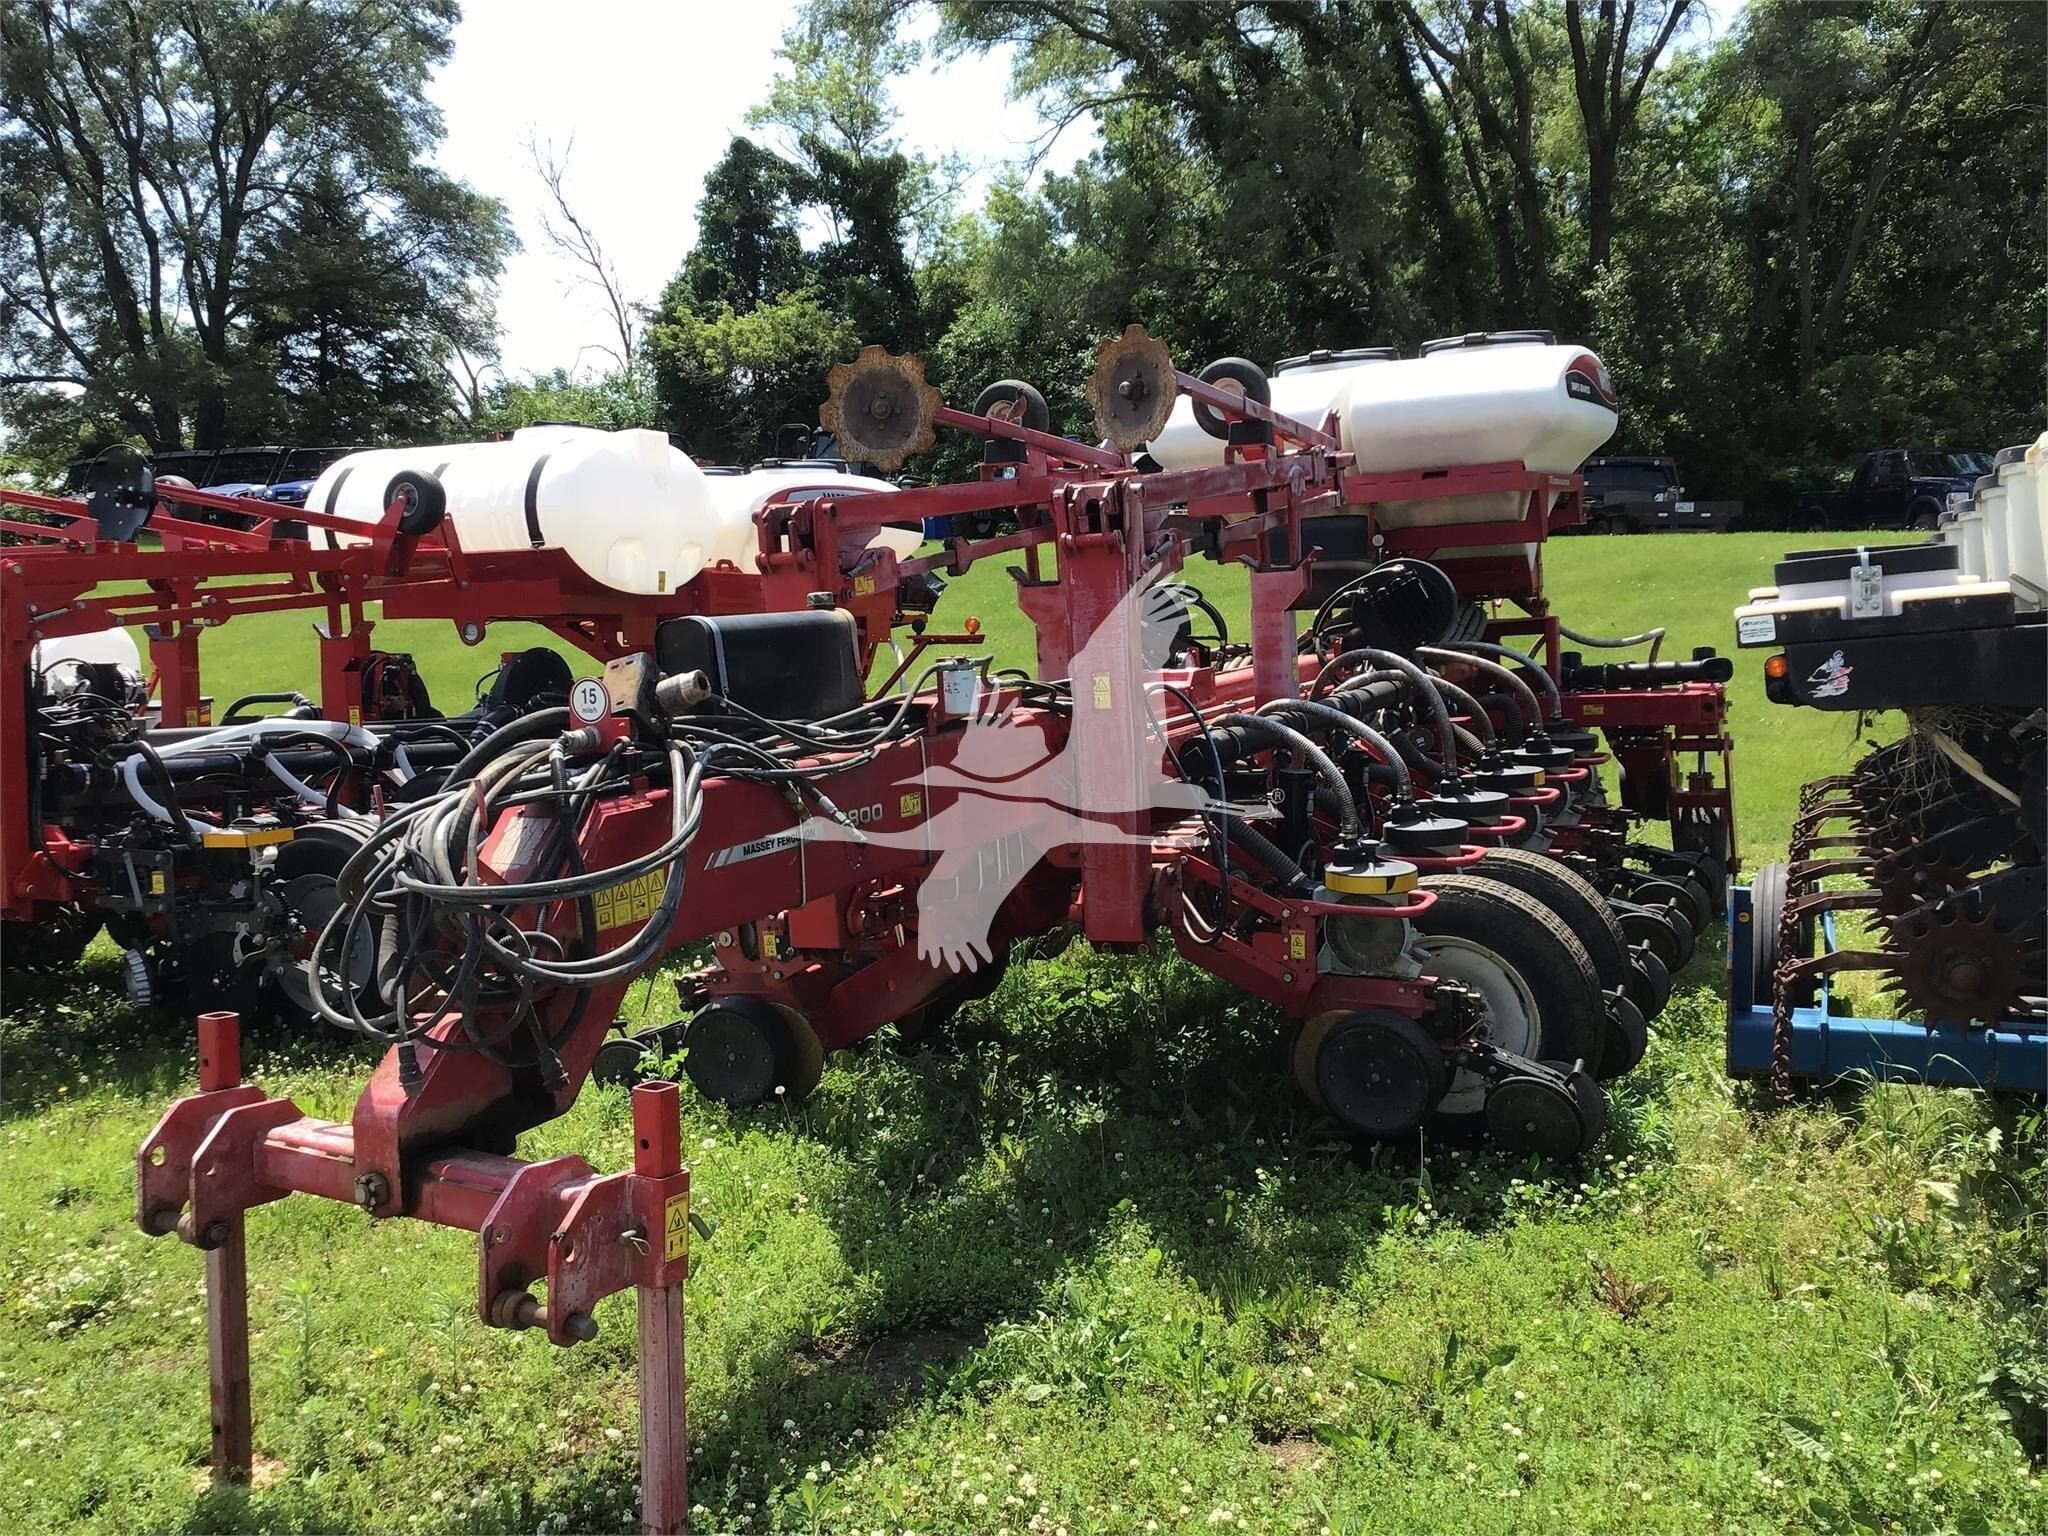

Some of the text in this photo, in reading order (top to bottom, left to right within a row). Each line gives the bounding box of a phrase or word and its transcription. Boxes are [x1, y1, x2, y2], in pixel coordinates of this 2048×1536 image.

[581, 687, 597, 705] 15
[833, 803, 883, 826] 800
[743, 827, 816, 857] MASSEY FERGUON
